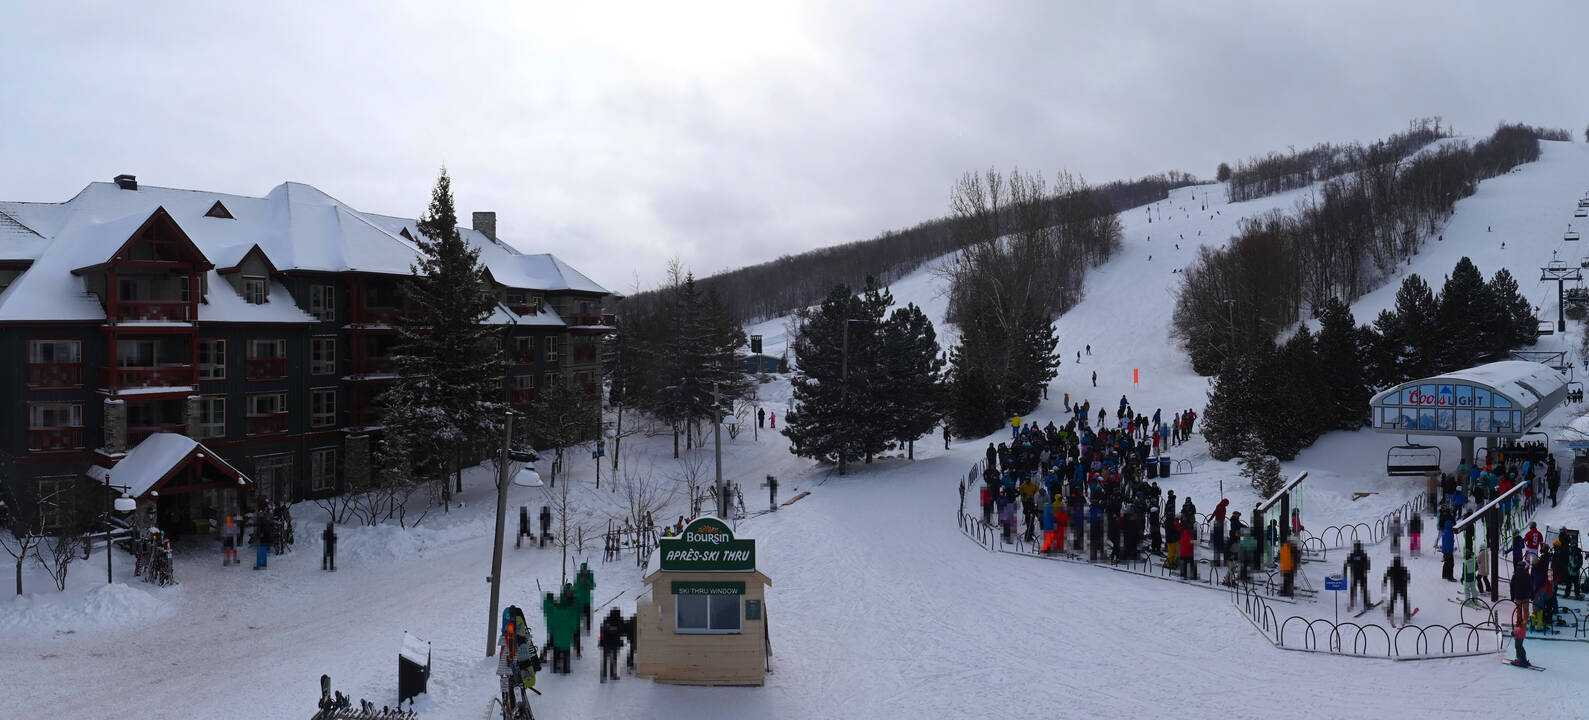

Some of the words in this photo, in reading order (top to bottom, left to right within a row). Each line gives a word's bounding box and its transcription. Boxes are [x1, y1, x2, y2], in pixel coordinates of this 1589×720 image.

[1408, 390, 1447, 405] Coos
[666, 549, 720, 561] APRÈS-SKI
[723, 551, 750, 561] THRU
